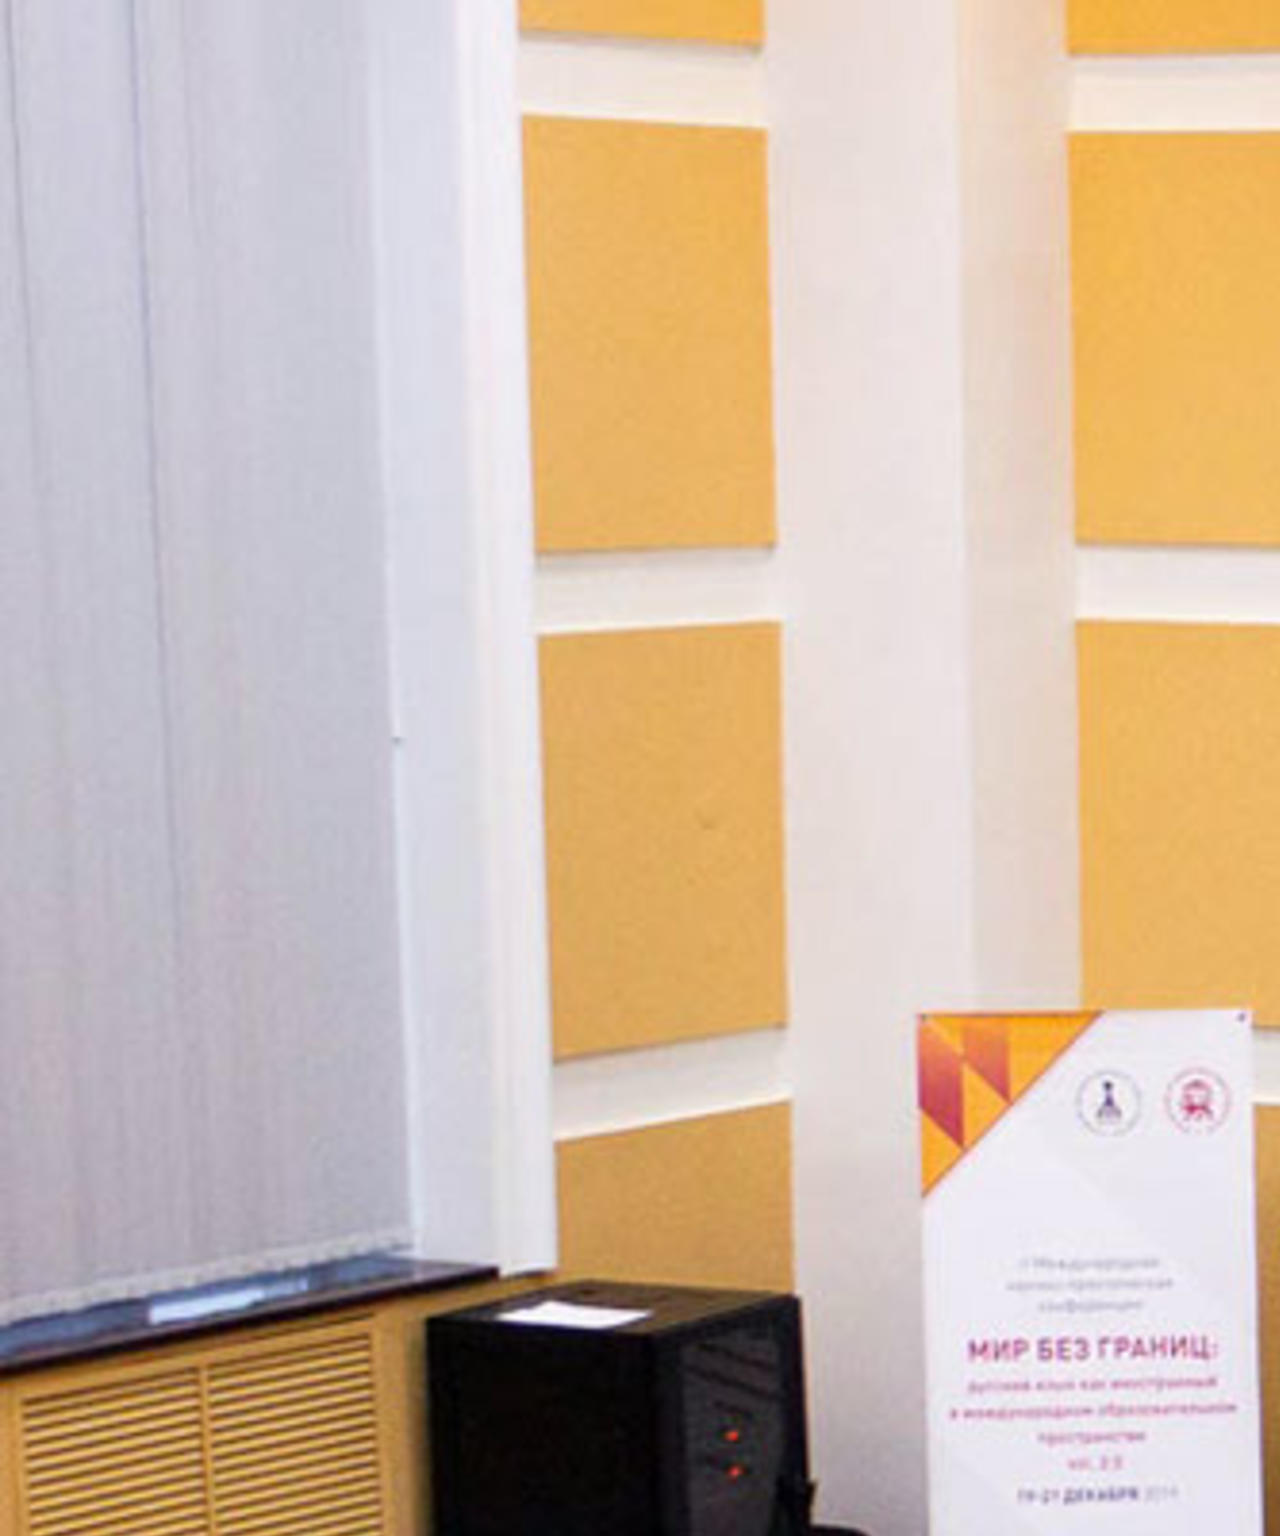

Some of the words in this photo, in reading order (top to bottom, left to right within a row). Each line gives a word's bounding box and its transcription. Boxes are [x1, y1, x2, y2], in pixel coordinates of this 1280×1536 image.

[969, 1338, 1029, 1362] МИР
[1037, 1336, 1090, 1361] БЕЗ
[1099, 1335, 1219, 1361] ГРАНИЦ:
